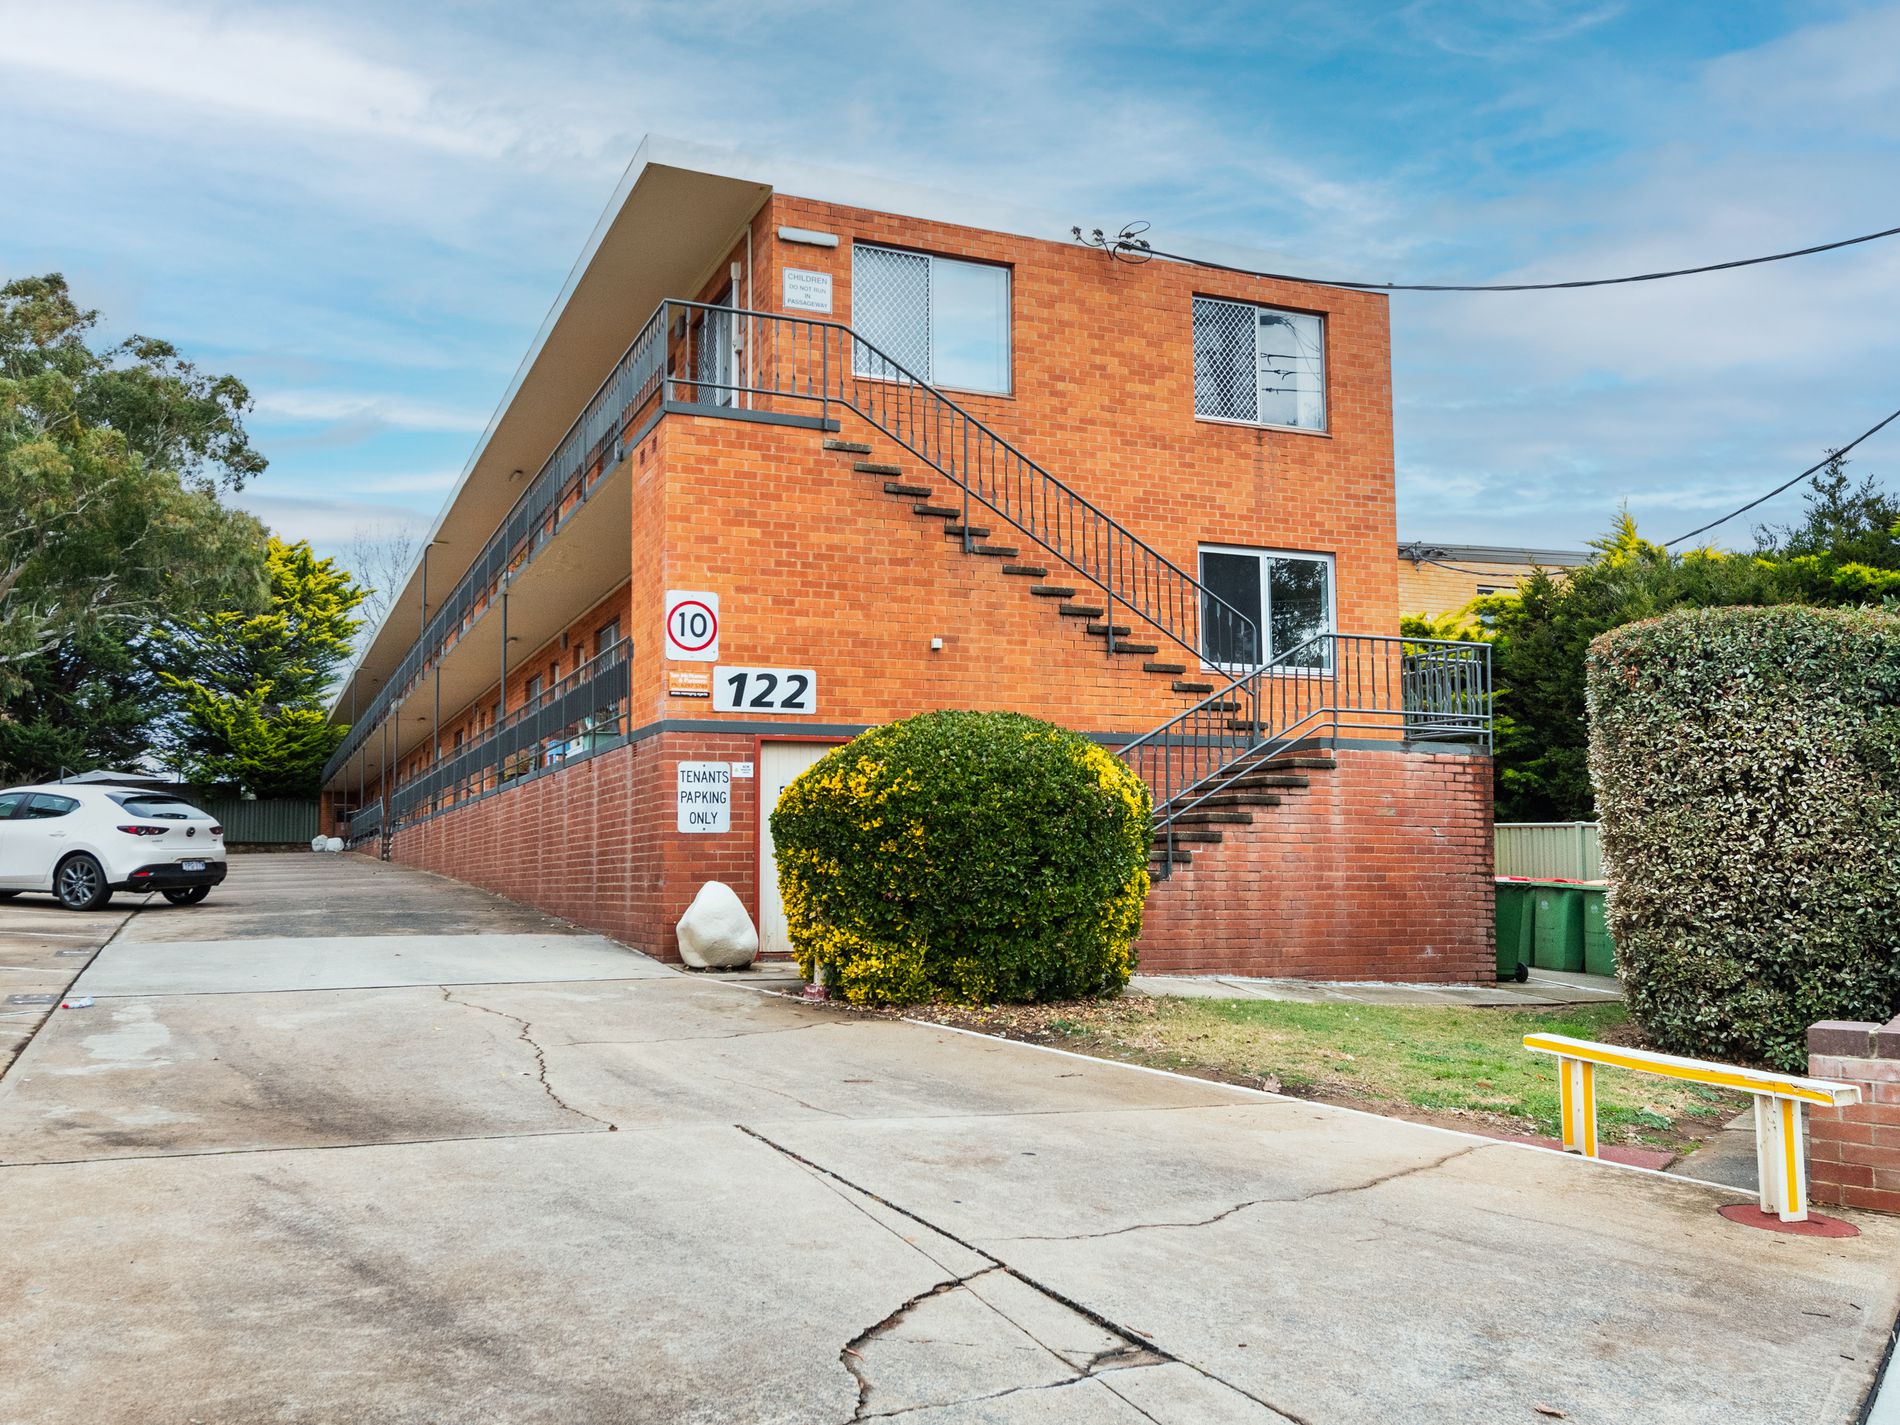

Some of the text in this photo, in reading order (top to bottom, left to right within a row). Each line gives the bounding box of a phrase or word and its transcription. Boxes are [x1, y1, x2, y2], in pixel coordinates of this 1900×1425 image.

[787, 273, 828, 284] CHILDREN
[787, 298, 828, 308] PASSAGEWAY
[679, 612, 707, 638] 10
[728, 673, 808, 709] 122
[680, 770, 729, 783] TENANTS
[689, 811, 718, 824] ONLY
